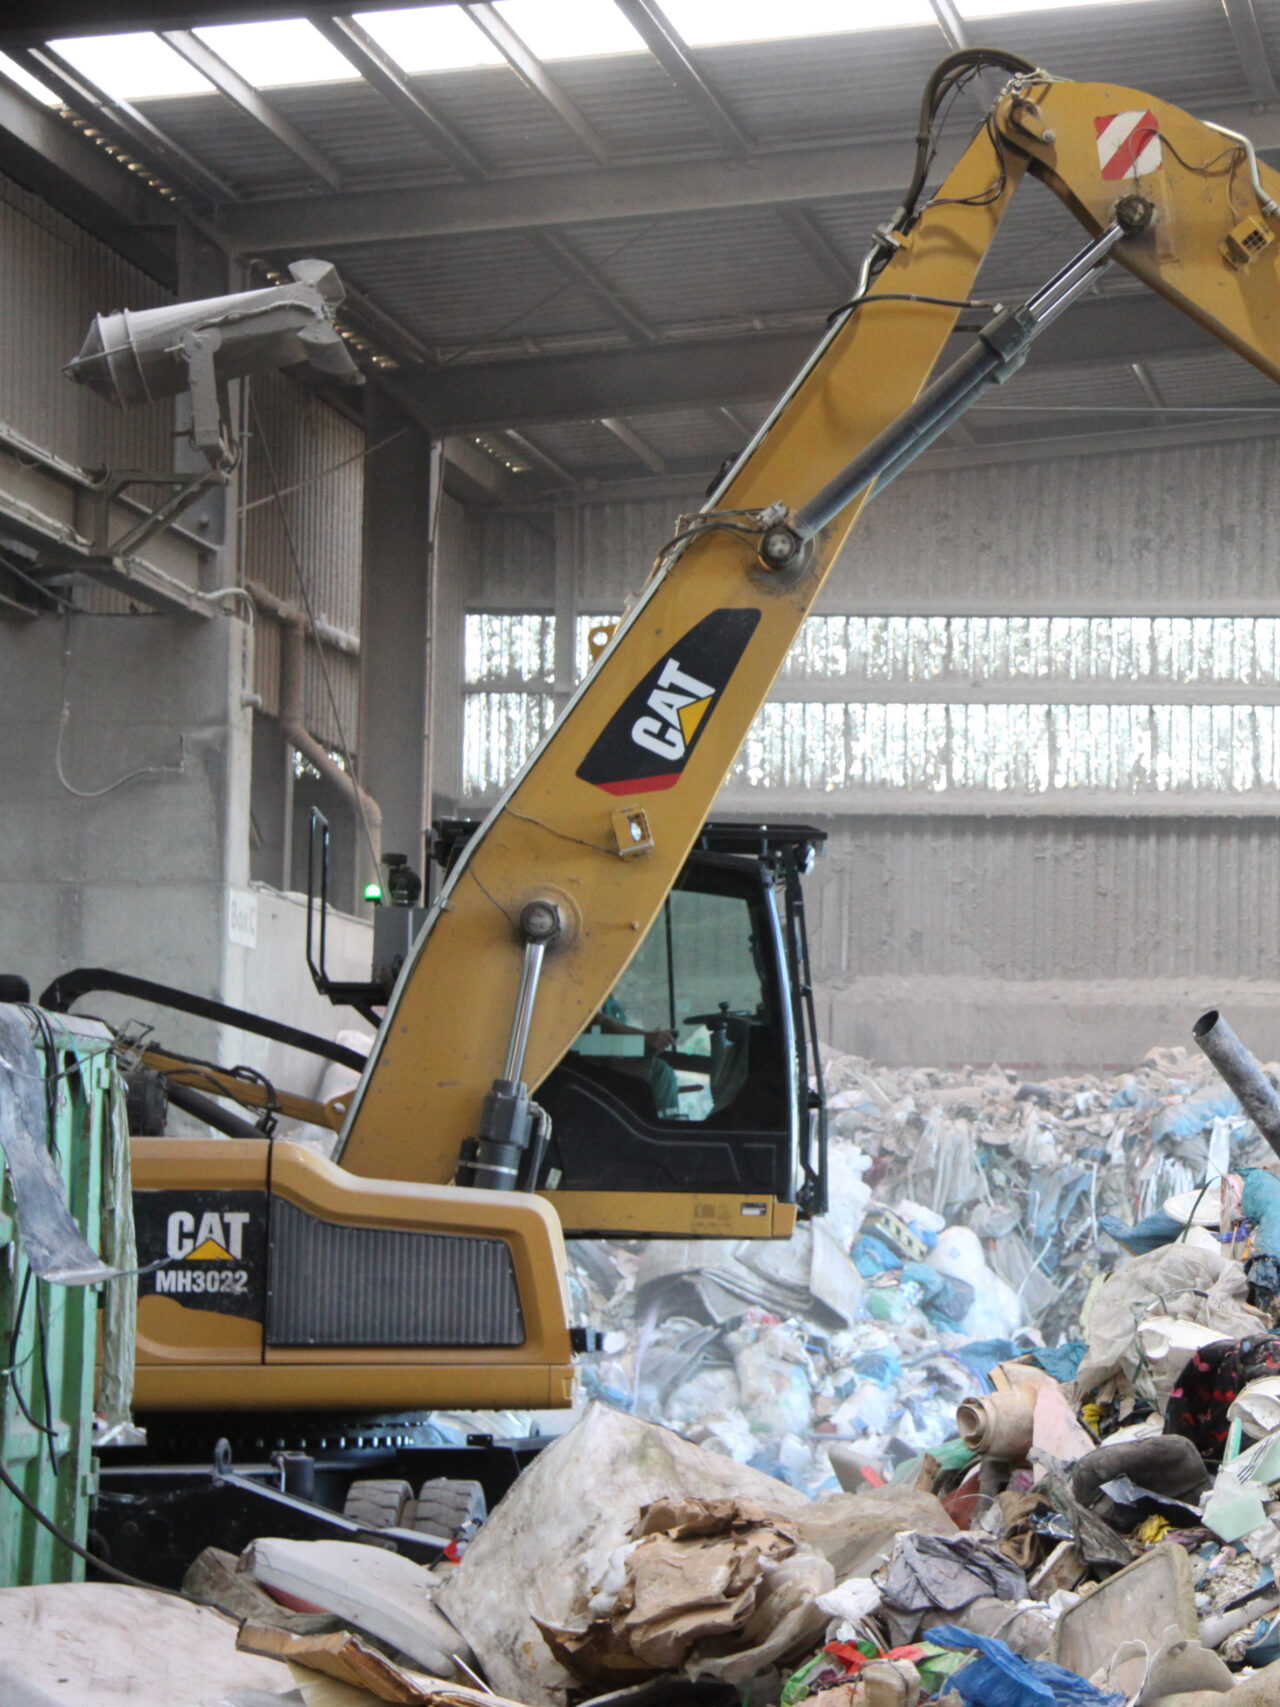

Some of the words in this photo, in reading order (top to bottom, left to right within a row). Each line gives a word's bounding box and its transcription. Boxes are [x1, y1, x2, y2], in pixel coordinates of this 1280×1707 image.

[631, 658, 716, 760] CAT
[167, 1210, 250, 1260] CAT
[155, 1270, 248, 1294] MH3022
